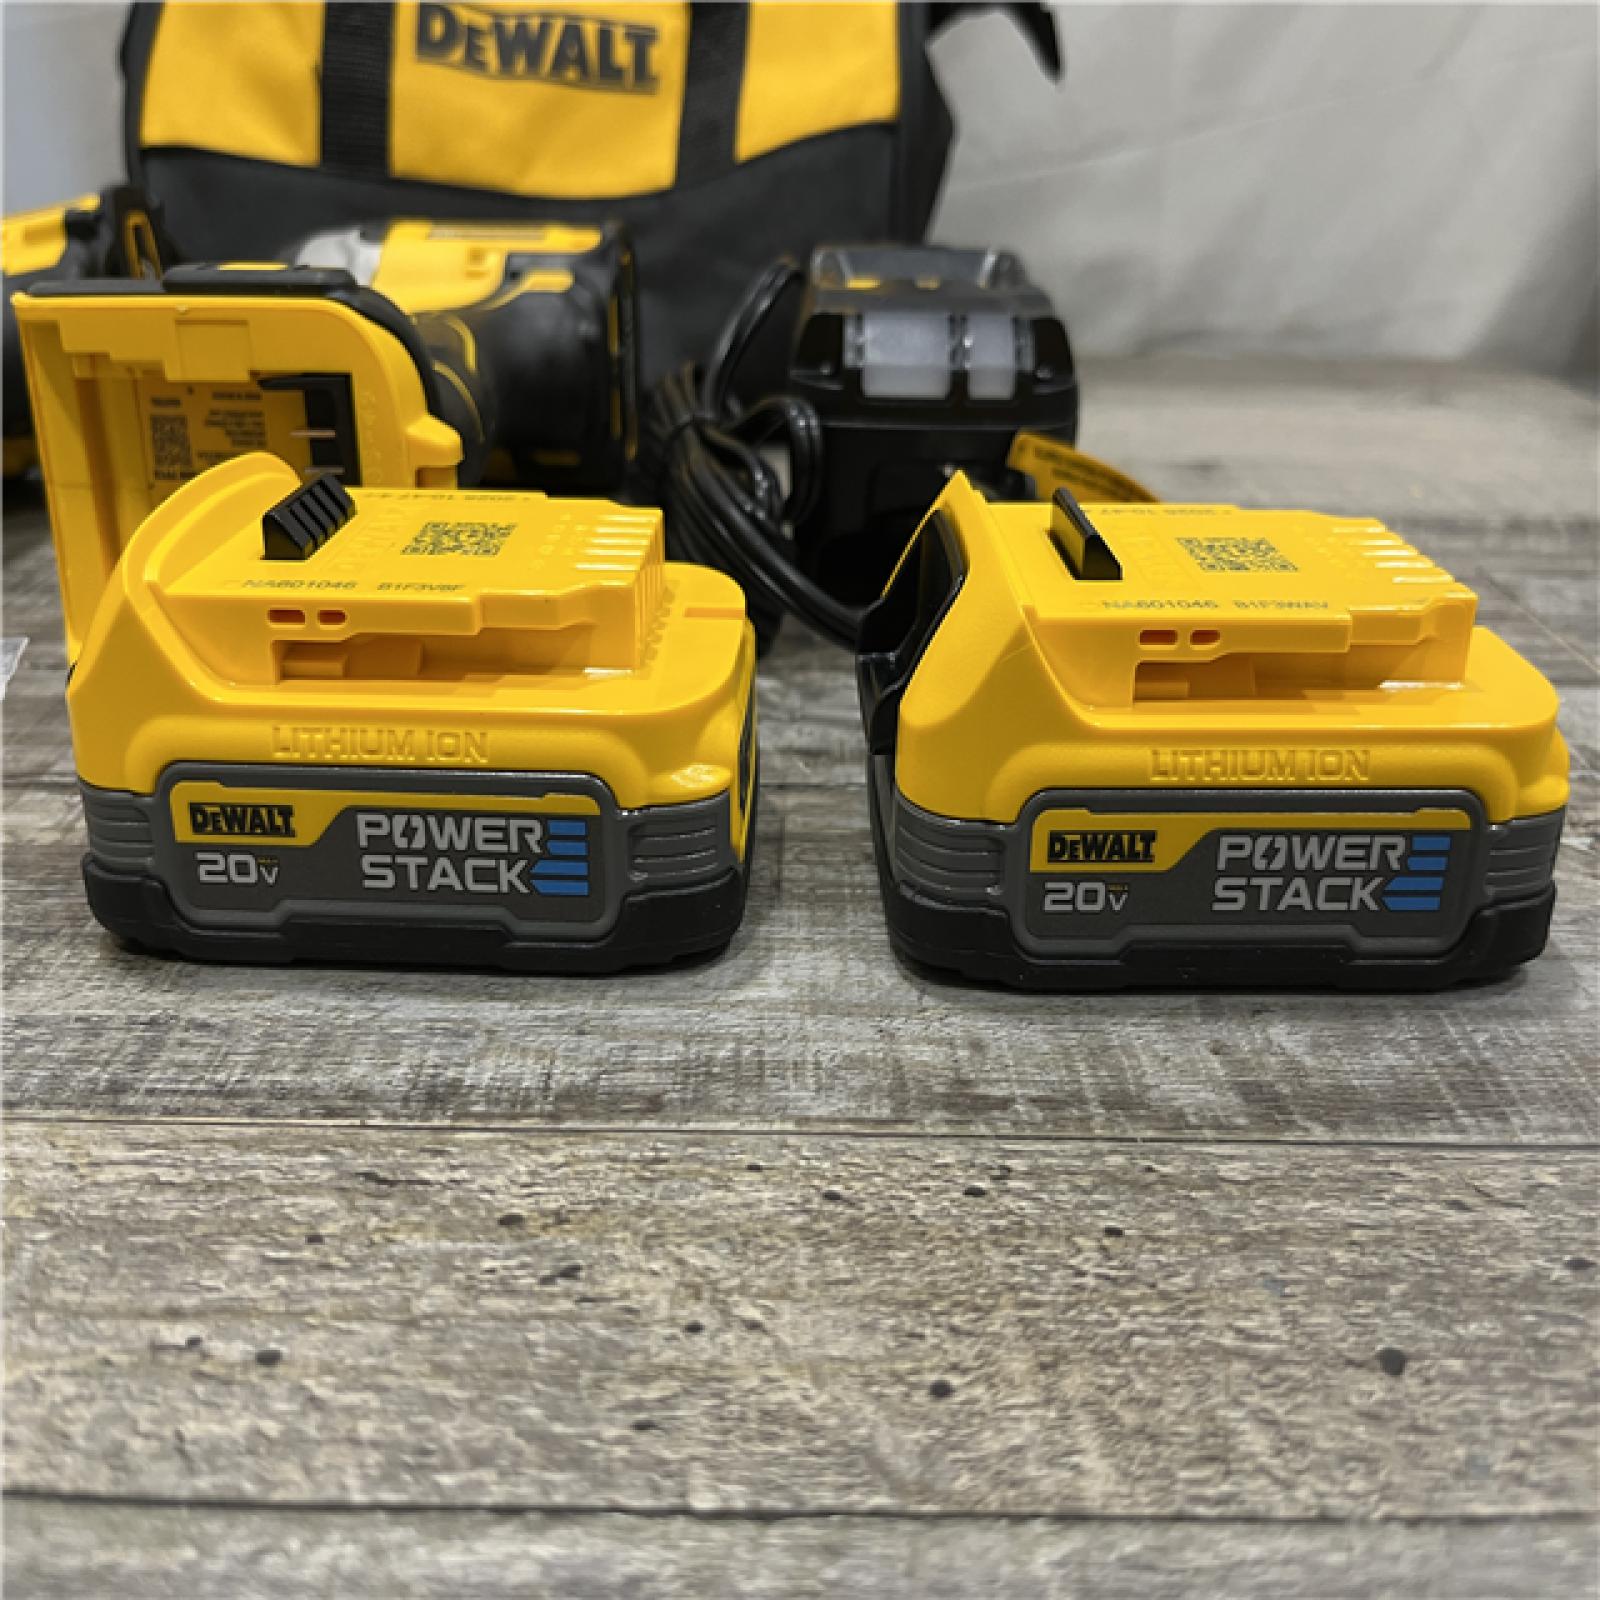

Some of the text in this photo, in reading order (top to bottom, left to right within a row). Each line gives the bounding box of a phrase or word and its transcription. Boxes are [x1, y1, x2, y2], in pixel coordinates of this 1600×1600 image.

[415, 2, 658, 93] DEWALT
[272, 726, 489, 764] LITHIUM ION
[1151, 748, 1370, 782] LITHIUM ION
[188, 802, 297, 838] DEWALT
[356, 812, 544, 854] POWER
[1047, 829, 1158, 864] DEWALT
[1216, 834, 1406, 872] POWER
[361, 853, 531, 894] STACK
[1210, 876, 1387, 912] STACK
